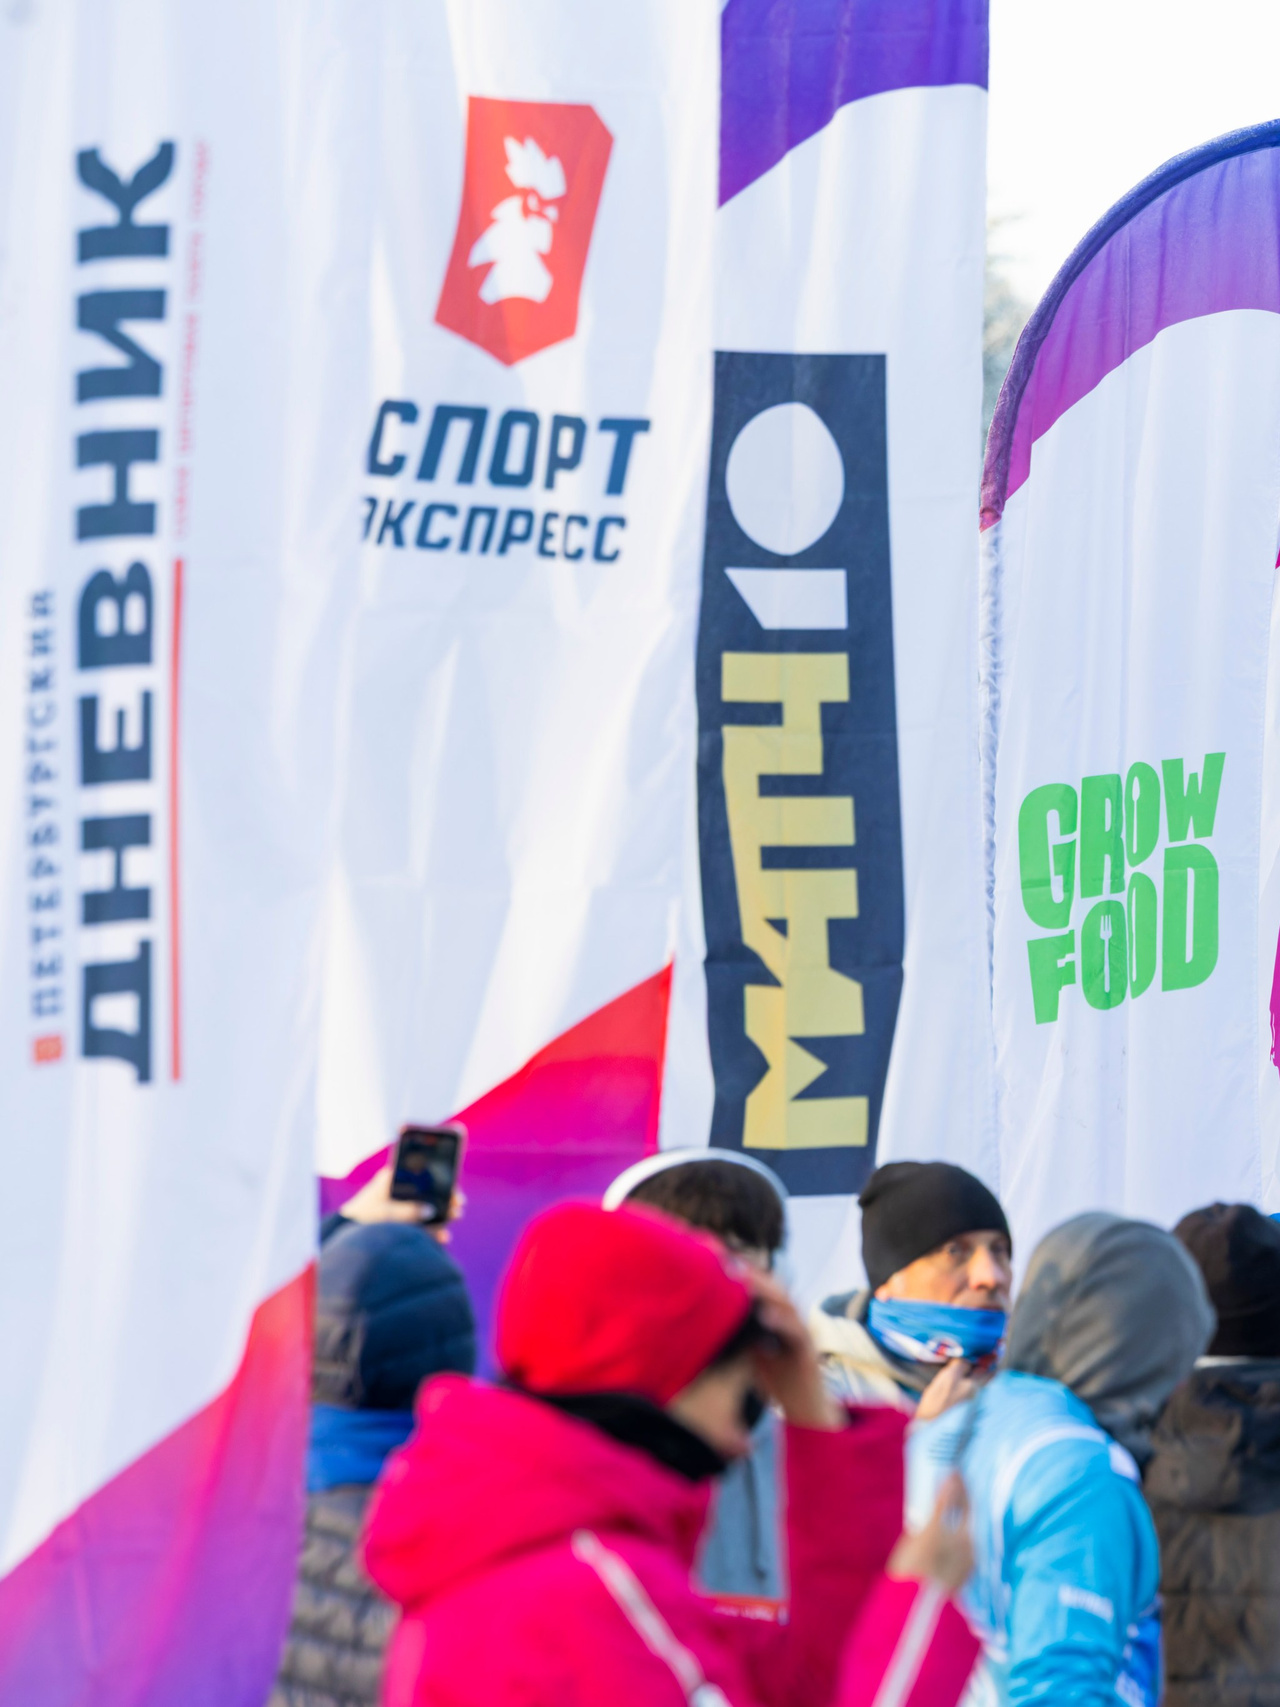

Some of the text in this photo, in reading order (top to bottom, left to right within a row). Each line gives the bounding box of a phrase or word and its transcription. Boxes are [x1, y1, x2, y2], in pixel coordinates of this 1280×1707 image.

[367, 399, 652, 496] СПОРТ
[76, 141, 176, 1083] ДНЕВНИК
[1017, 751, 1227, 930] GROW
[1026, 843, 1221, 1026] FOOD
